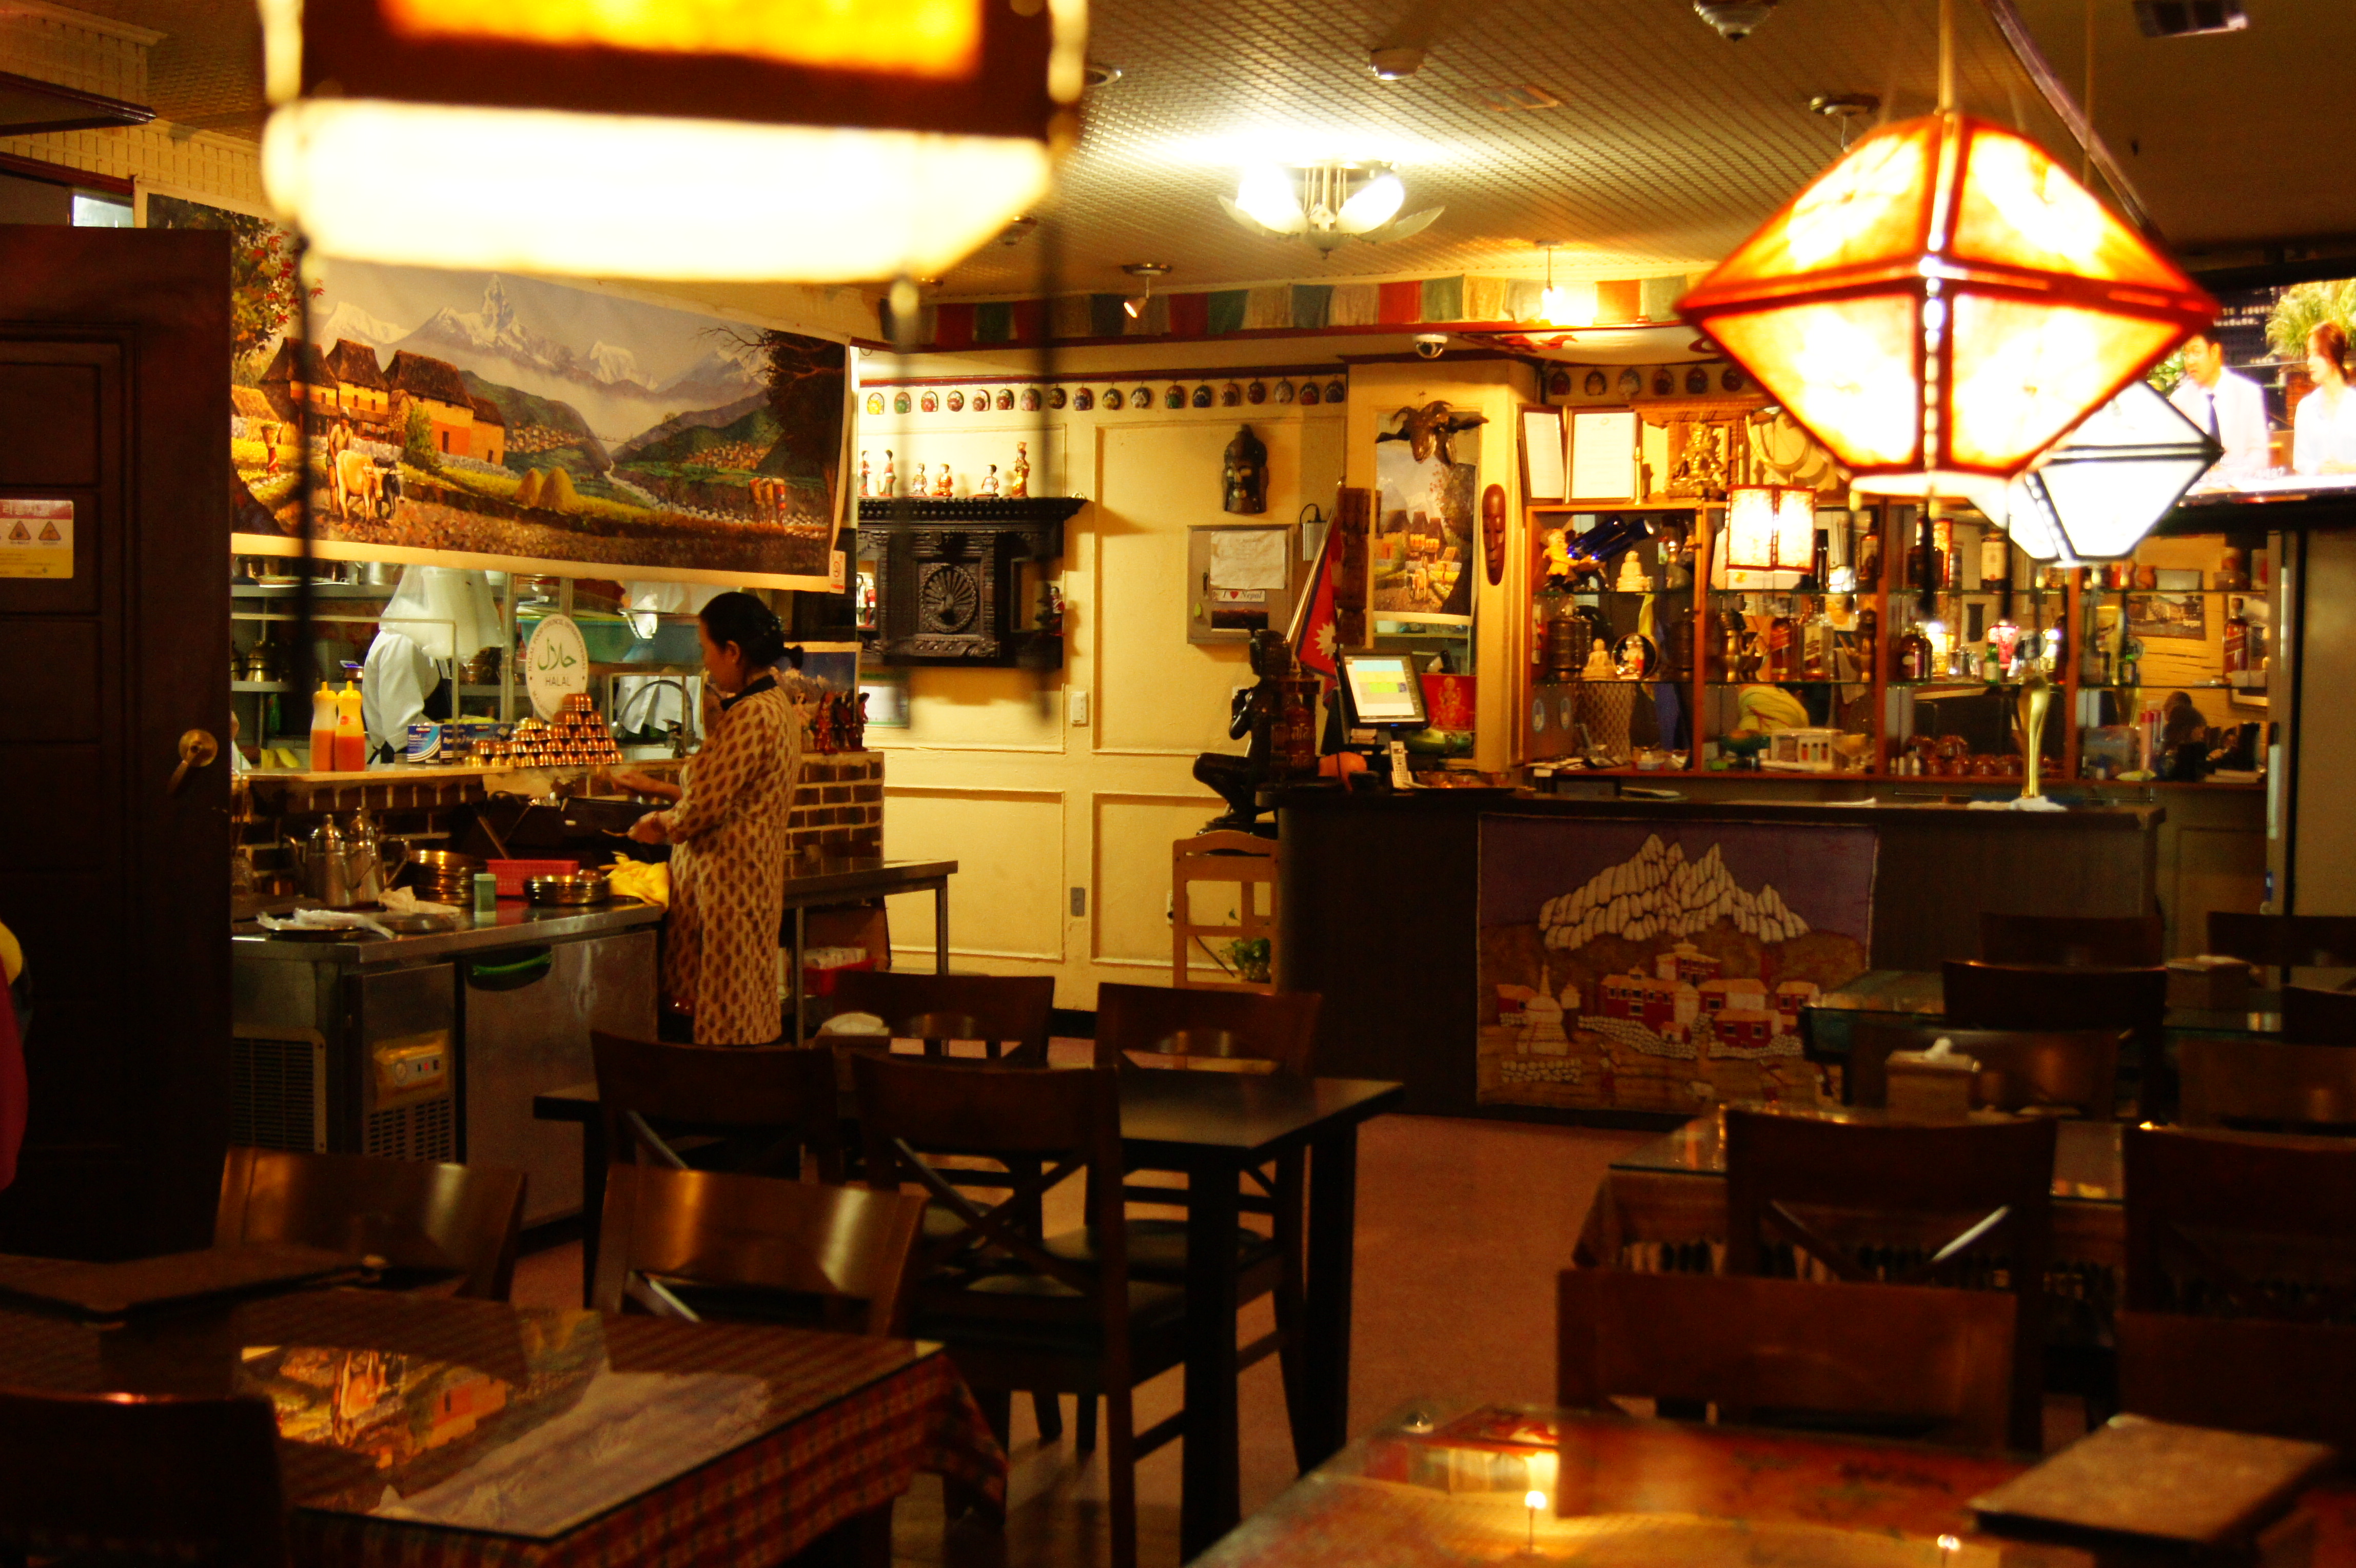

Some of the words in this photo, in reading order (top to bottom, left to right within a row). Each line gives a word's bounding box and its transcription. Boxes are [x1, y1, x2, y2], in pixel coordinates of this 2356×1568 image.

[1241, 590, 1263, 600] Nepal
[537, 637, 577, 671] حلال
[545, 676, 572, 687] HALAL
